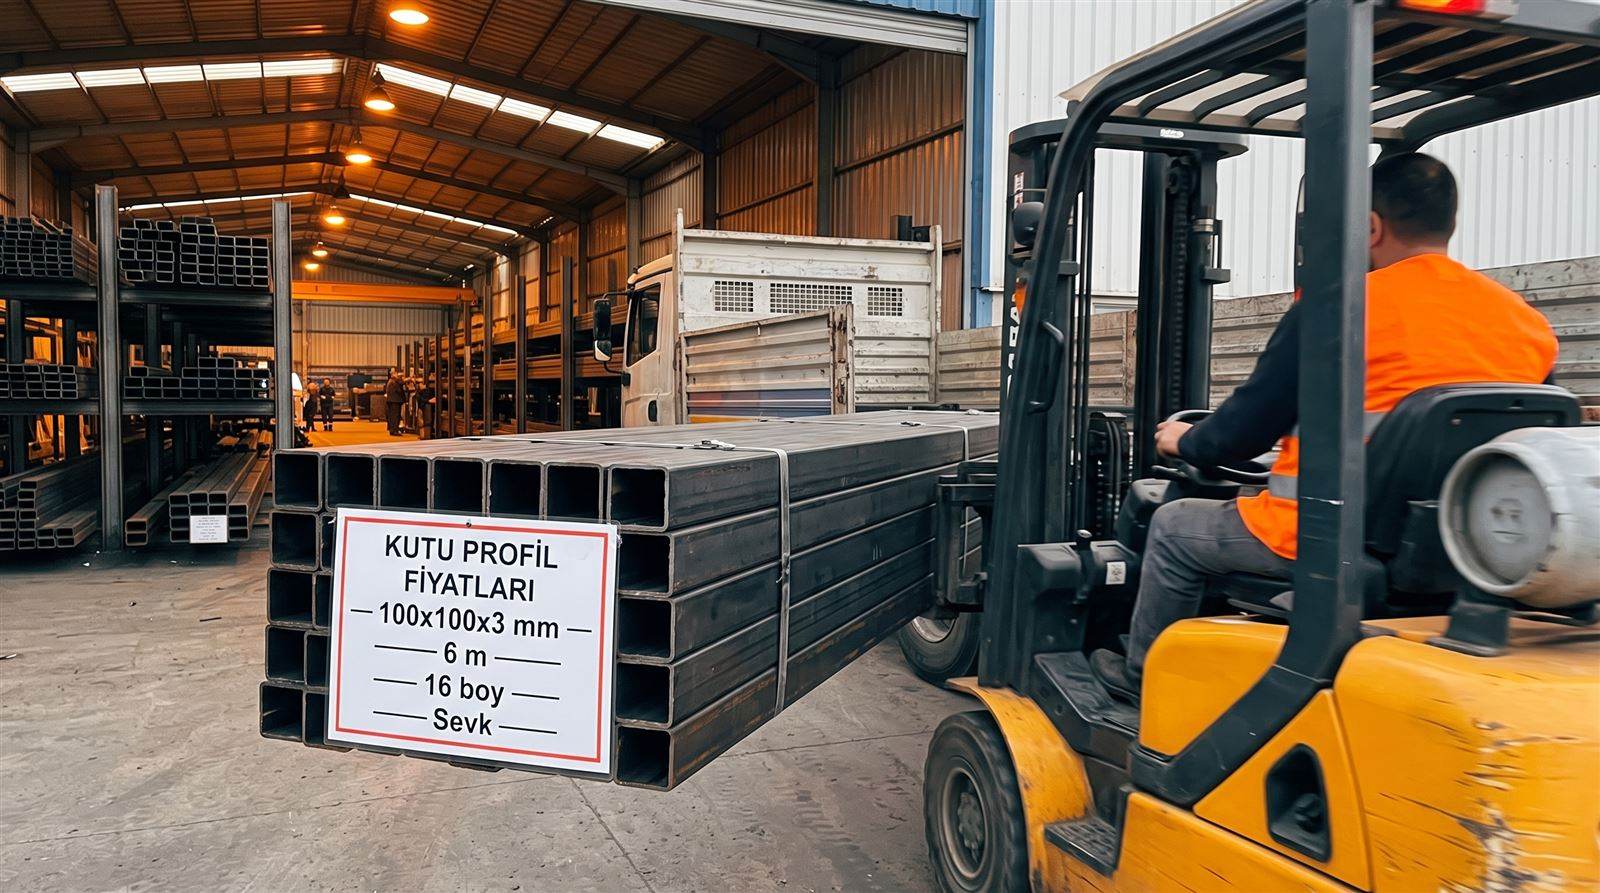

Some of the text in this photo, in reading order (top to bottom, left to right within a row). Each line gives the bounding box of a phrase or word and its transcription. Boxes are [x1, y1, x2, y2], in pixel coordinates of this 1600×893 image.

[385, 534, 558, 569] KUTU PROFİL
[404, 565, 534, 602] FİYATLARI
[379, 601, 559, 639] 100x100x3 mm
[444, 641, 487, 667] 6 m
[425, 673, 505, 709] 16 boy
[432, 707, 492, 736] Sevk
